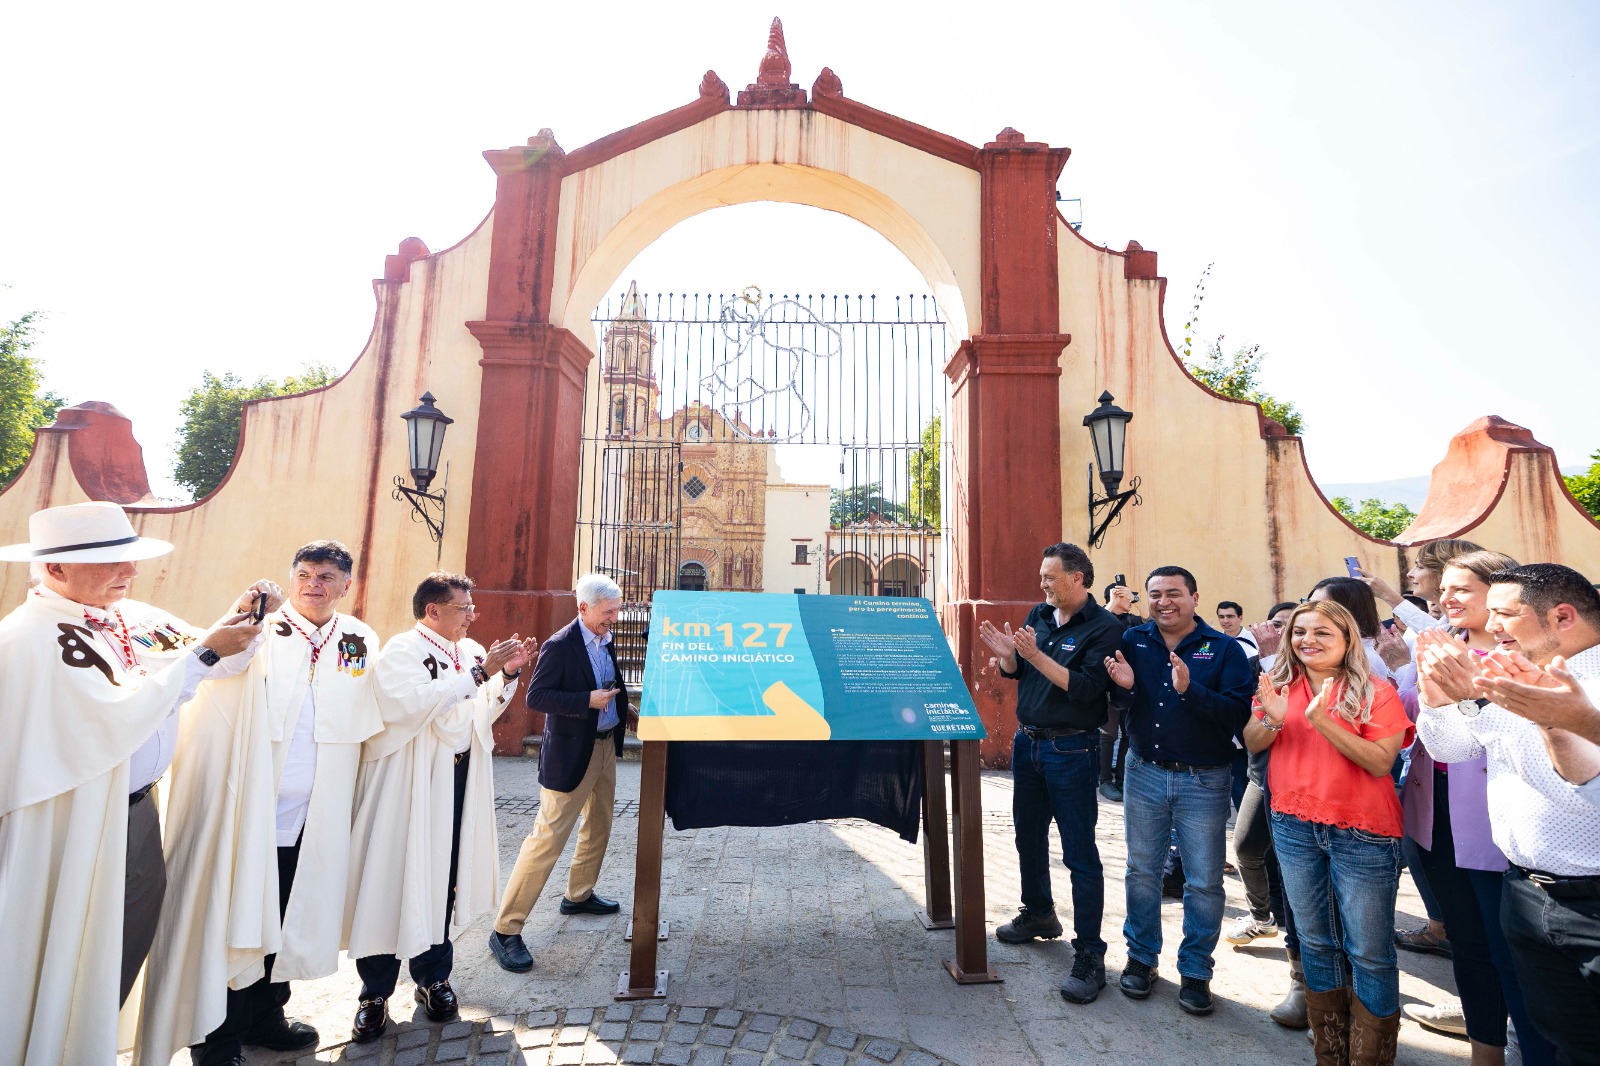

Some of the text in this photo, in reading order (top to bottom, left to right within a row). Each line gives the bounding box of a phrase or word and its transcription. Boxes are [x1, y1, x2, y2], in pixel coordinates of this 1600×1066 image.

[662, 617, 793, 648] km 127
[662, 642, 714, 651] FIN DEL
[661, 652, 795, 663] CAMINO INICIÁTICO
[930, 724, 976, 732] QUERÉTARO
